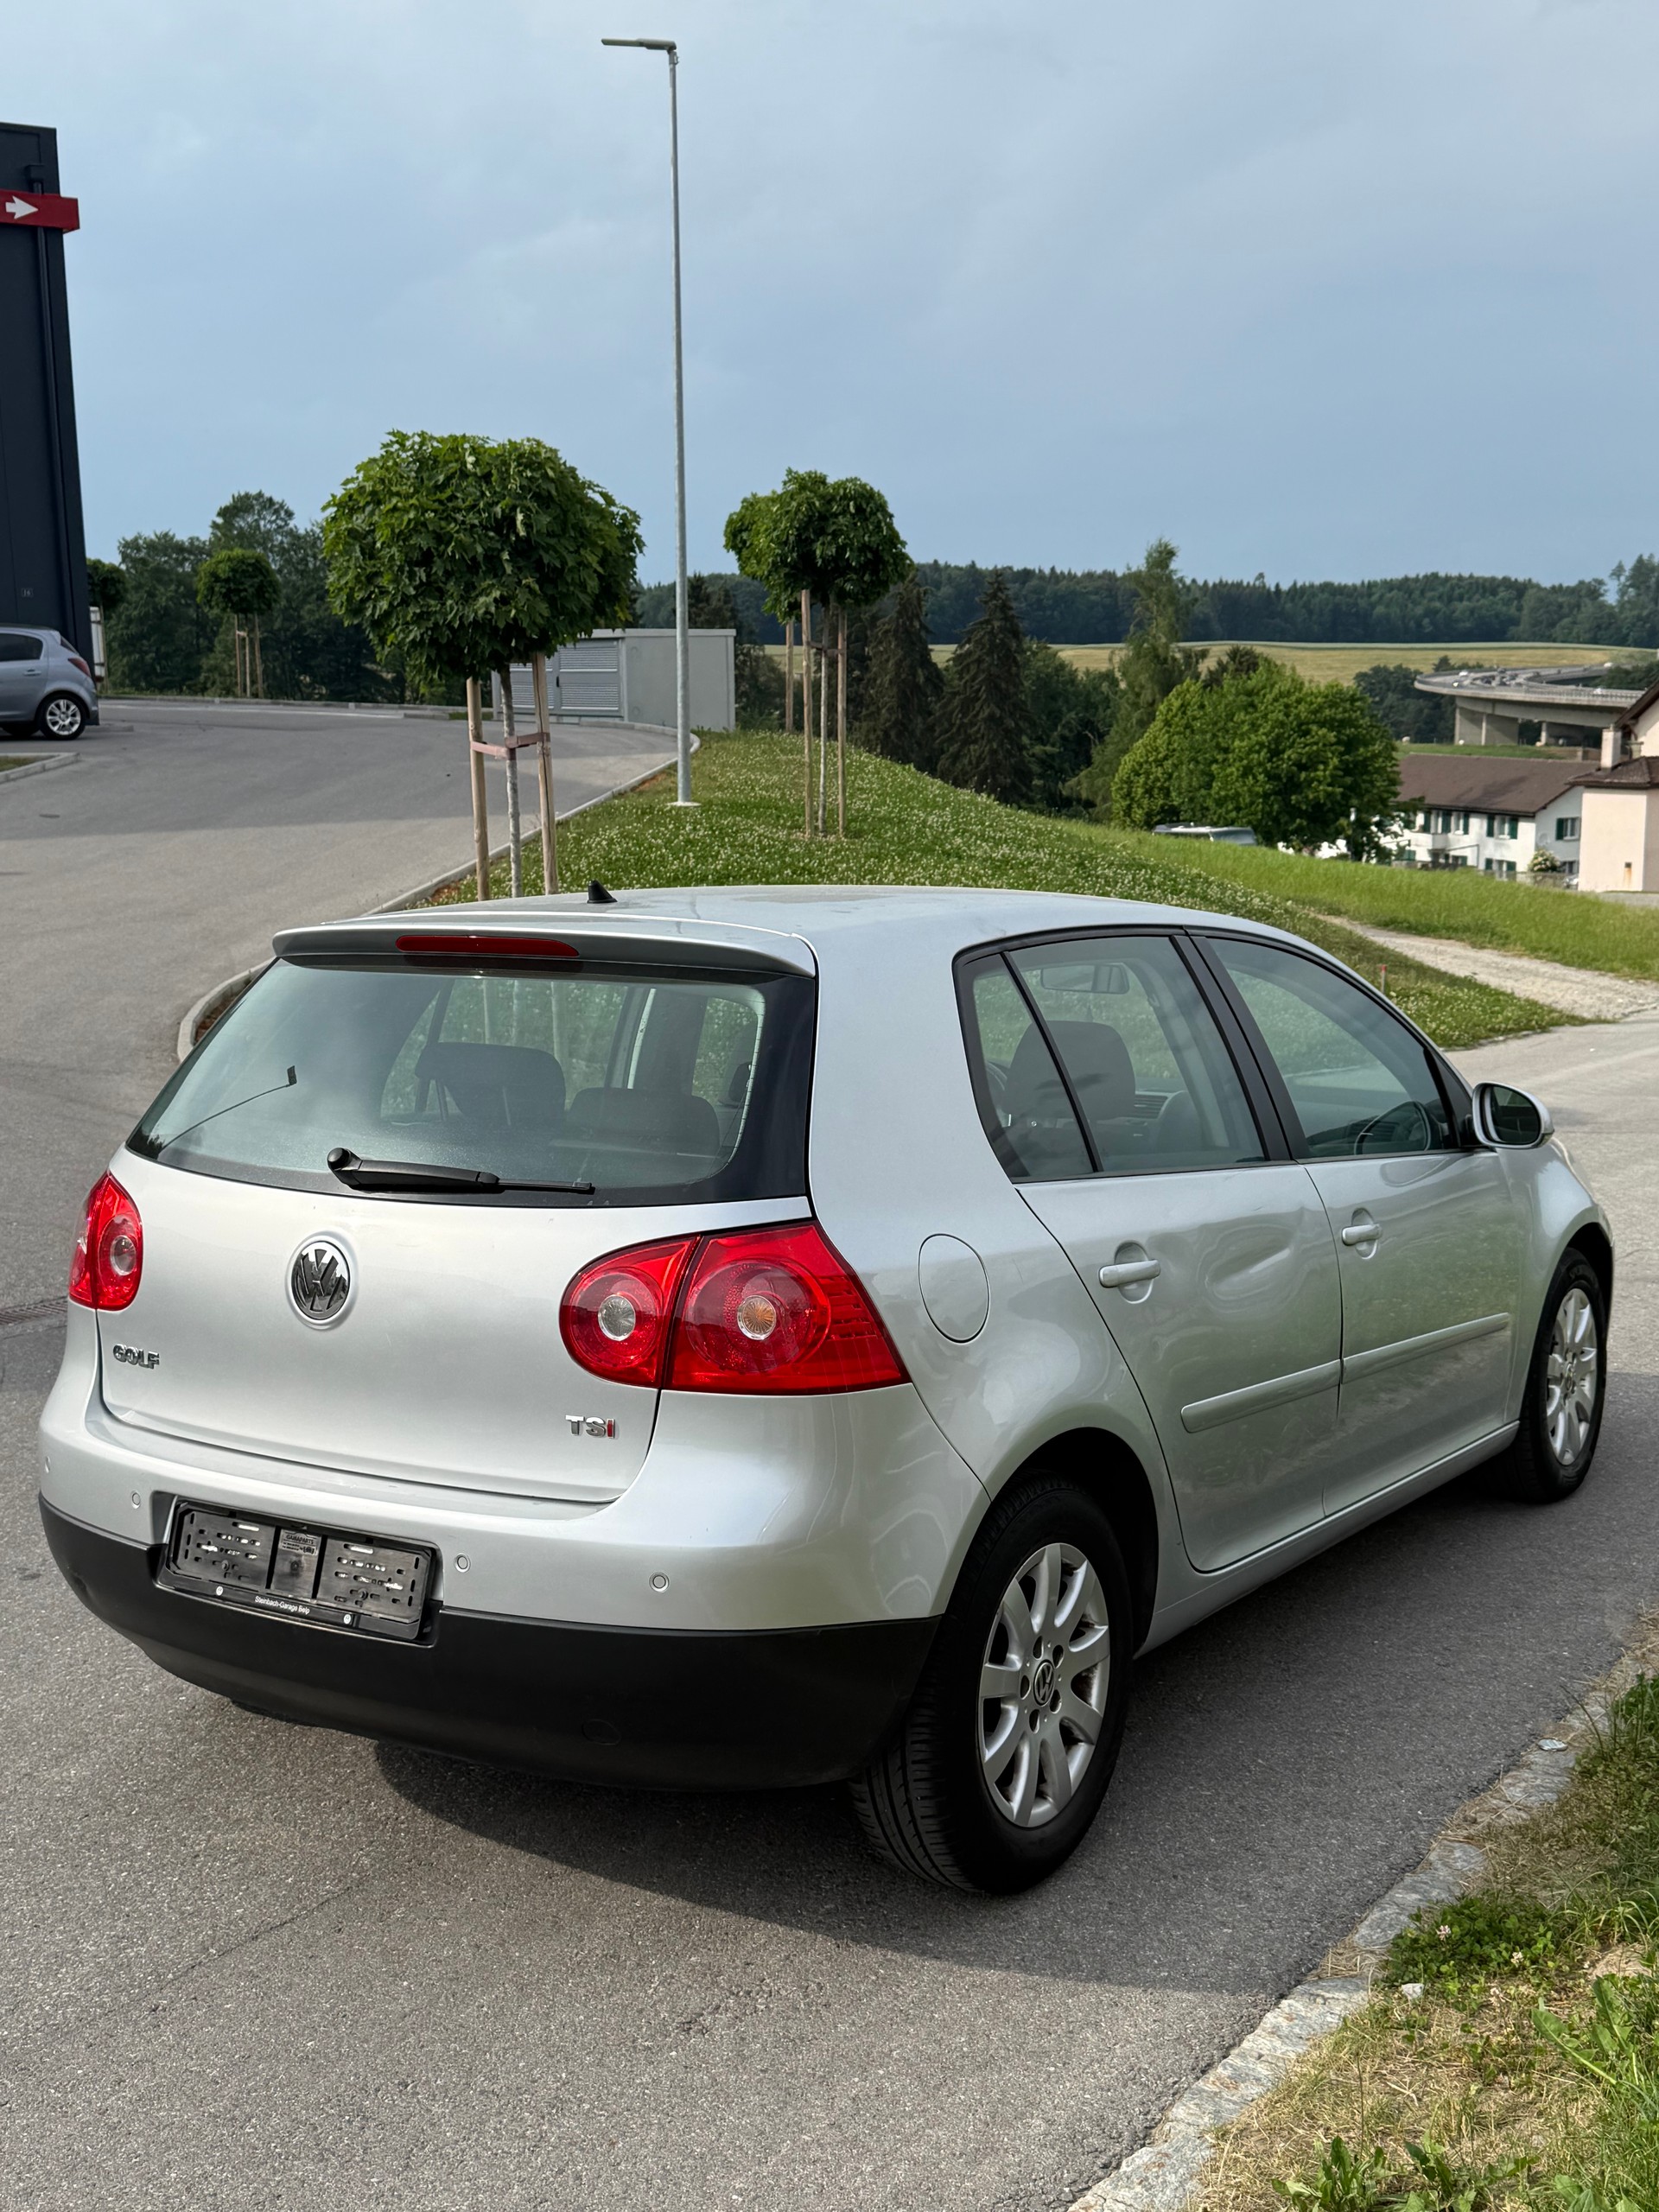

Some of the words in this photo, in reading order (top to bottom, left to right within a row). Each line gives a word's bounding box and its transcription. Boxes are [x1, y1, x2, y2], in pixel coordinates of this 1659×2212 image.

[292, 1244, 349, 1318] VW
[113, 1344, 159, 1370] GOLF
[565, 1414, 615, 1439] TSI
[255, 1596, 297, 1612] Steinbach-Garage
[298, 1605, 310, 1615] Belp
